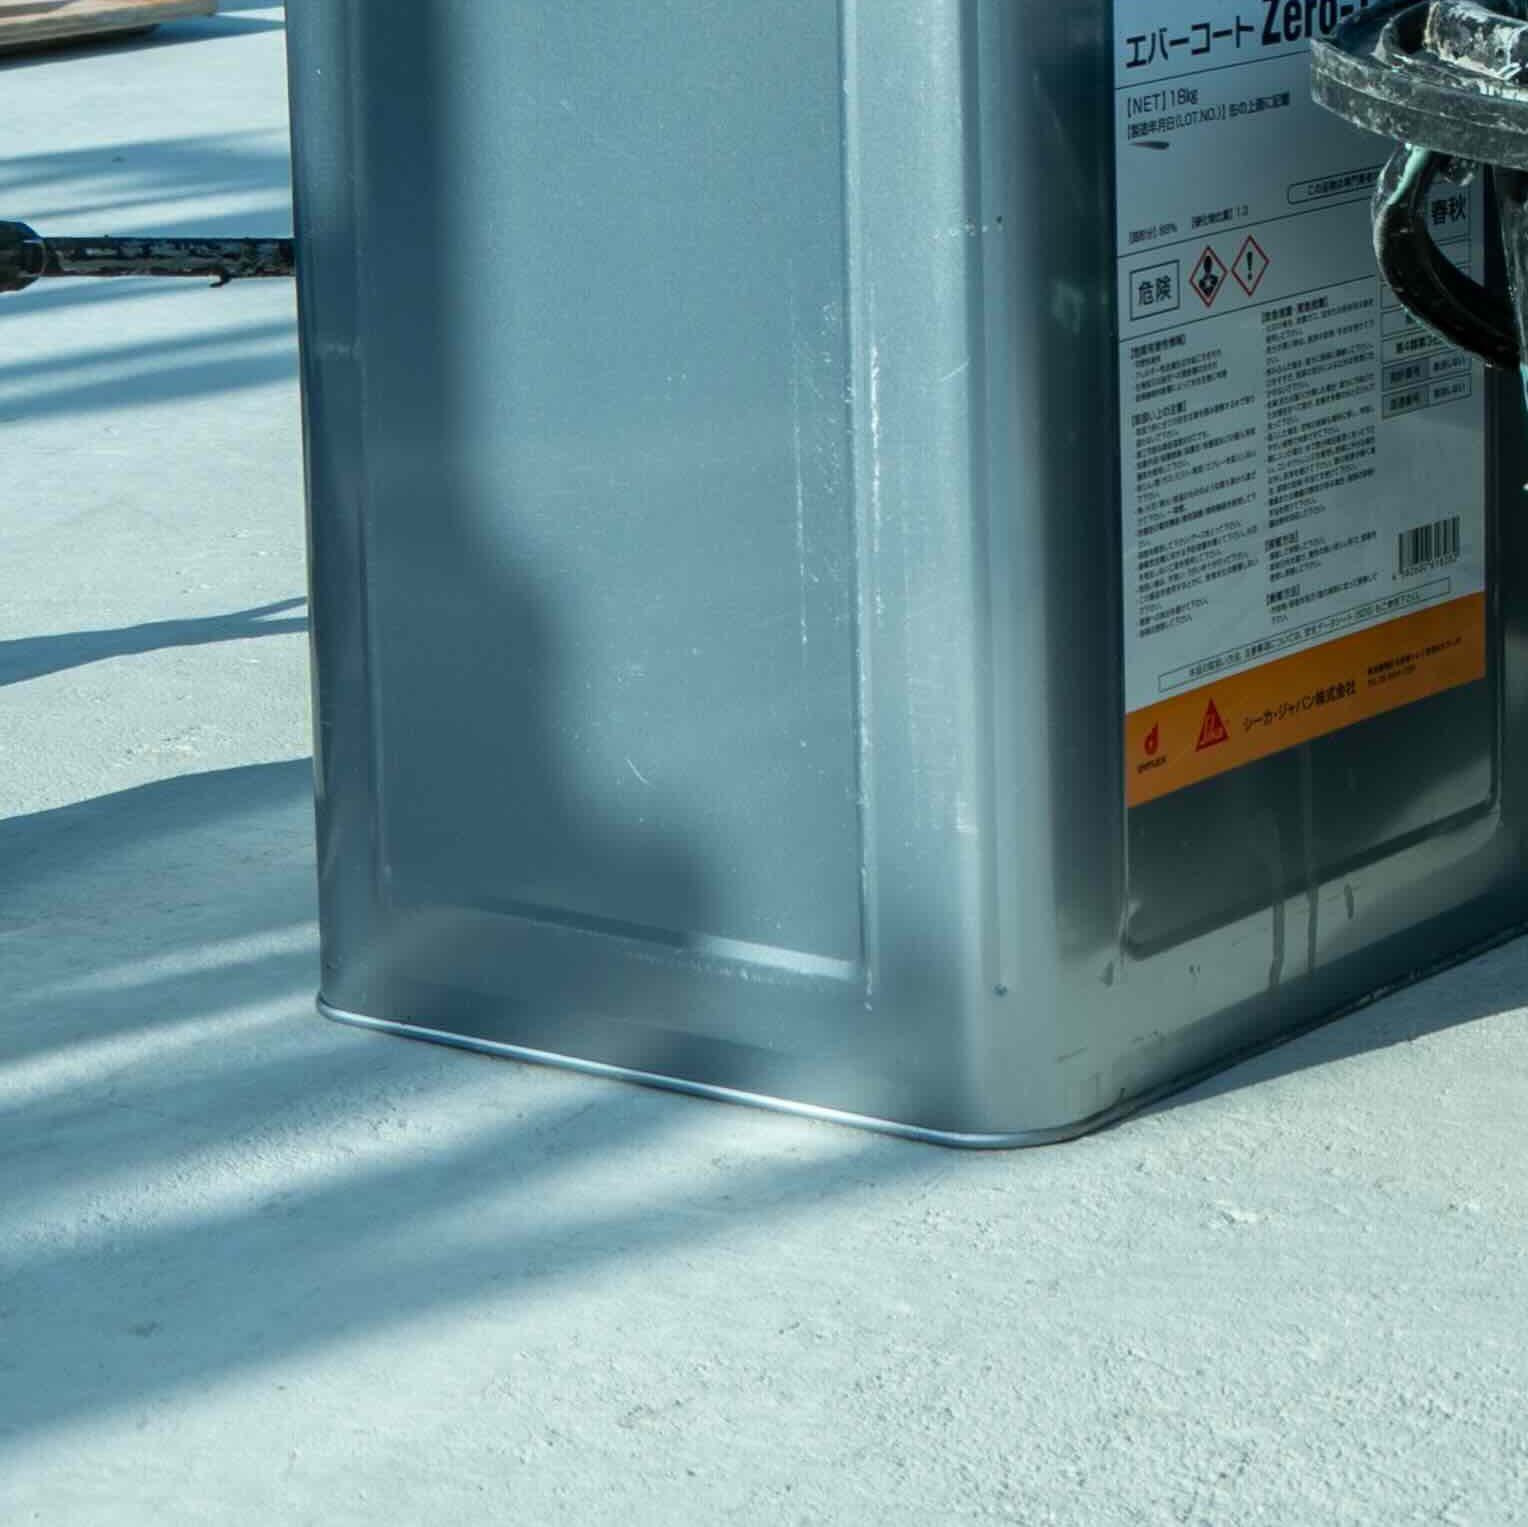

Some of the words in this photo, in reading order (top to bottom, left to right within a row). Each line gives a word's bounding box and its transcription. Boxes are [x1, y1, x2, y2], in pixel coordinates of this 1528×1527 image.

[1126, 15, 1255, 69] エバーコート
[1137, 275, 1173, 307] 危険
